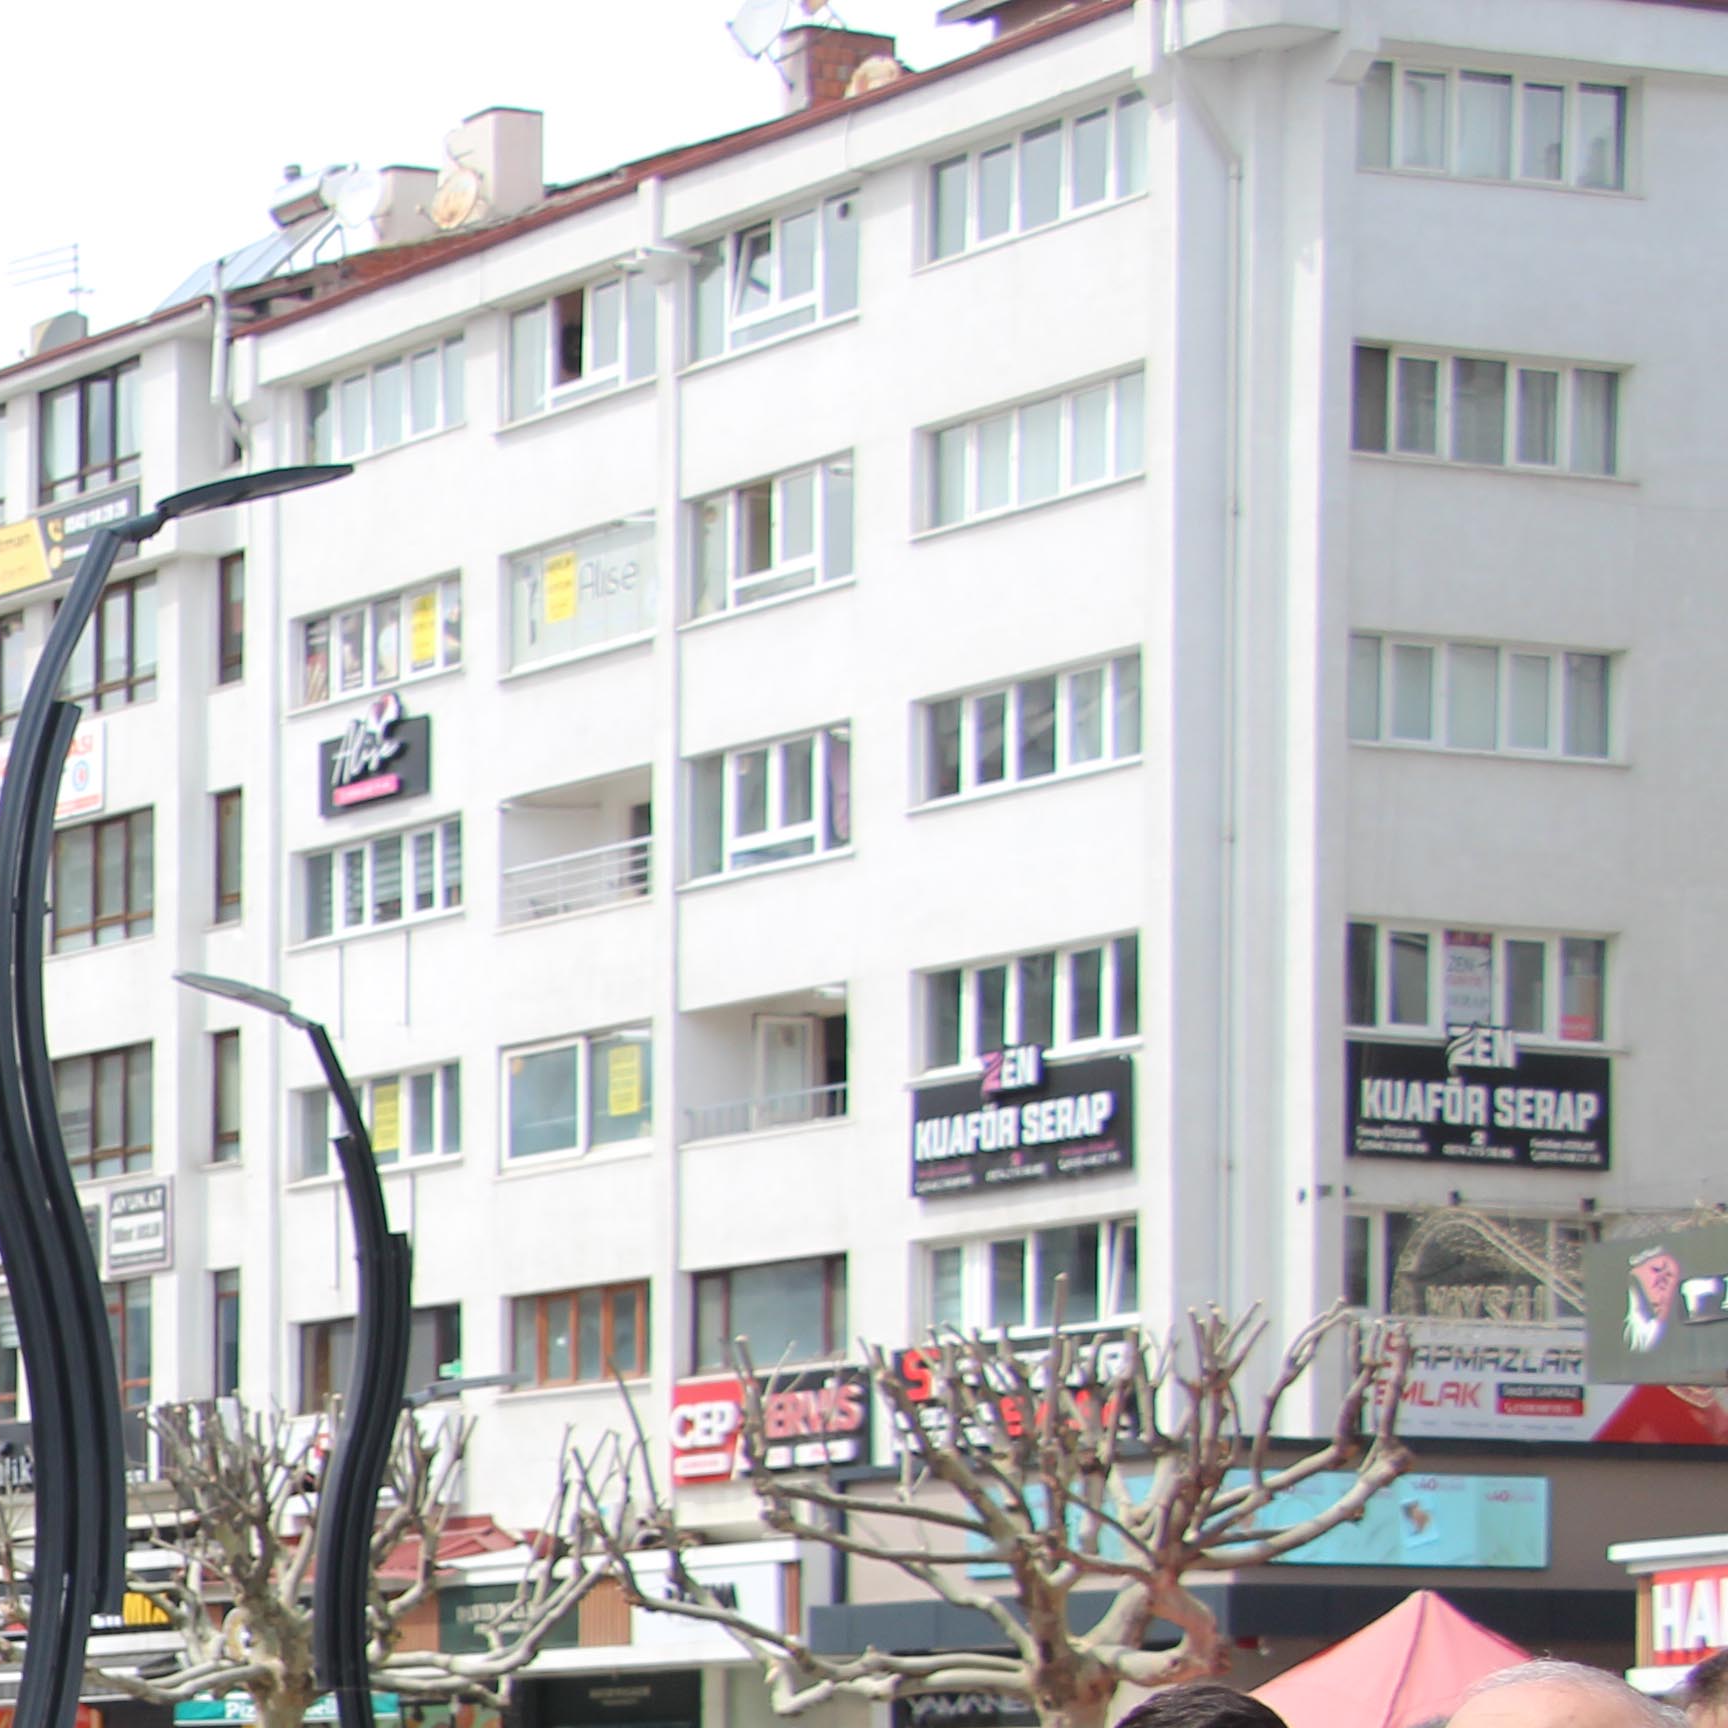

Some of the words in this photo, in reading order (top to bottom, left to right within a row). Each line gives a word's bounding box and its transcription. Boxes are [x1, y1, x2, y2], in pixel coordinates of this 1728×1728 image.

[981, 1045, 1040, 1094] ZEN
[1446, 1024, 1521, 1072] ZEN
[915, 1103, 1020, 1161] KUAFÖR
[1021, 1090, 1113, 1145] SERAP
[1361, 1078, 1488, 1126] KUAFÖR
[1494, 1087, 1599, 1132] SERAP
[669, 1401, 739, 1448] CEP
[1651, 1577, 1728, 1652] HA
